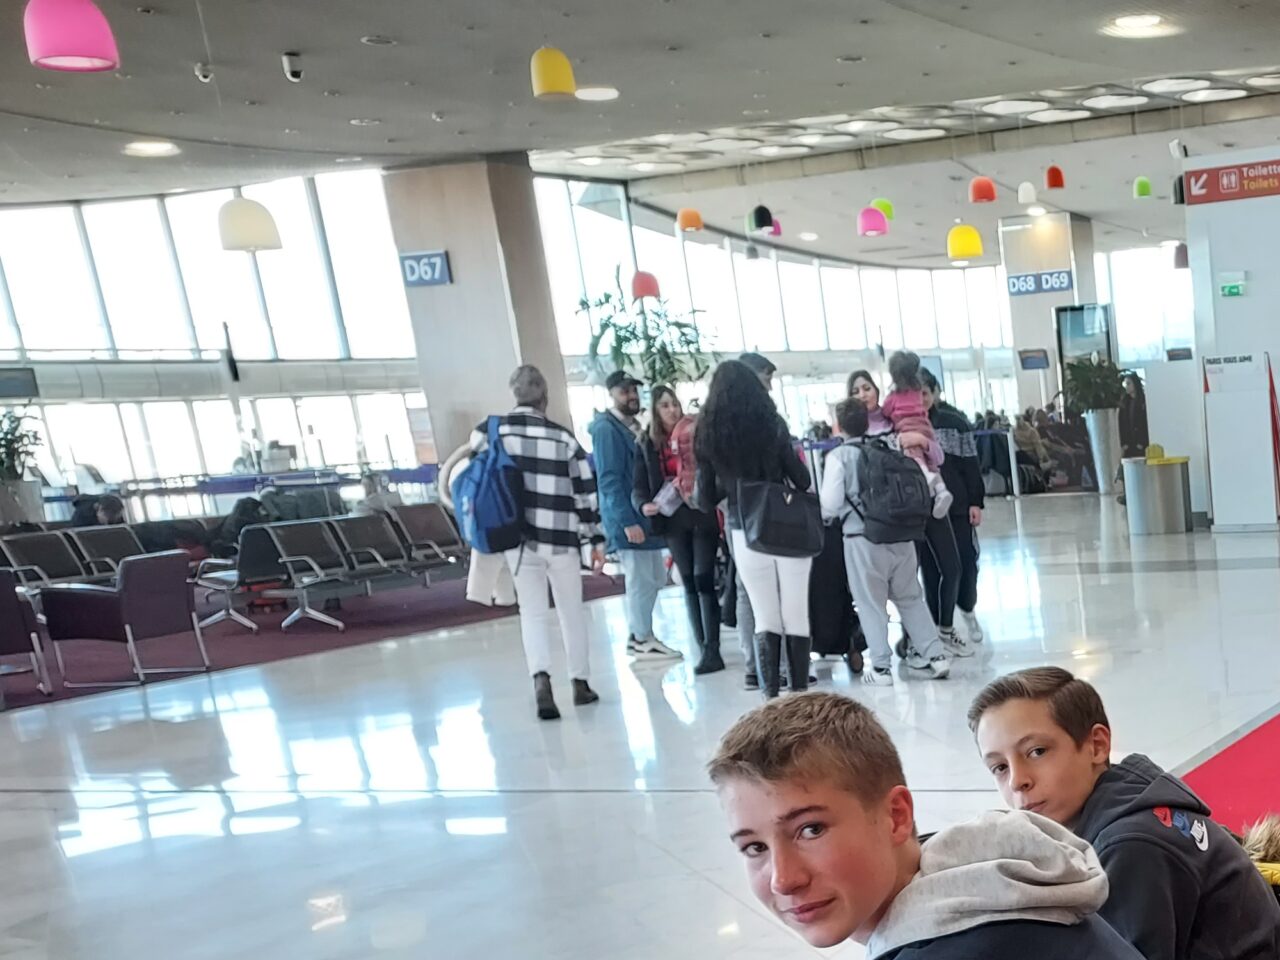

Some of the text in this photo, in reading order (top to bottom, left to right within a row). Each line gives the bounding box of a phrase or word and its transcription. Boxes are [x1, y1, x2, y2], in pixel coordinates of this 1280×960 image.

[1243, 178, 1279, 190] Toilets
[404, 257, 442, 281] D67
[1009, 272, 1069, 292] D68 D69
